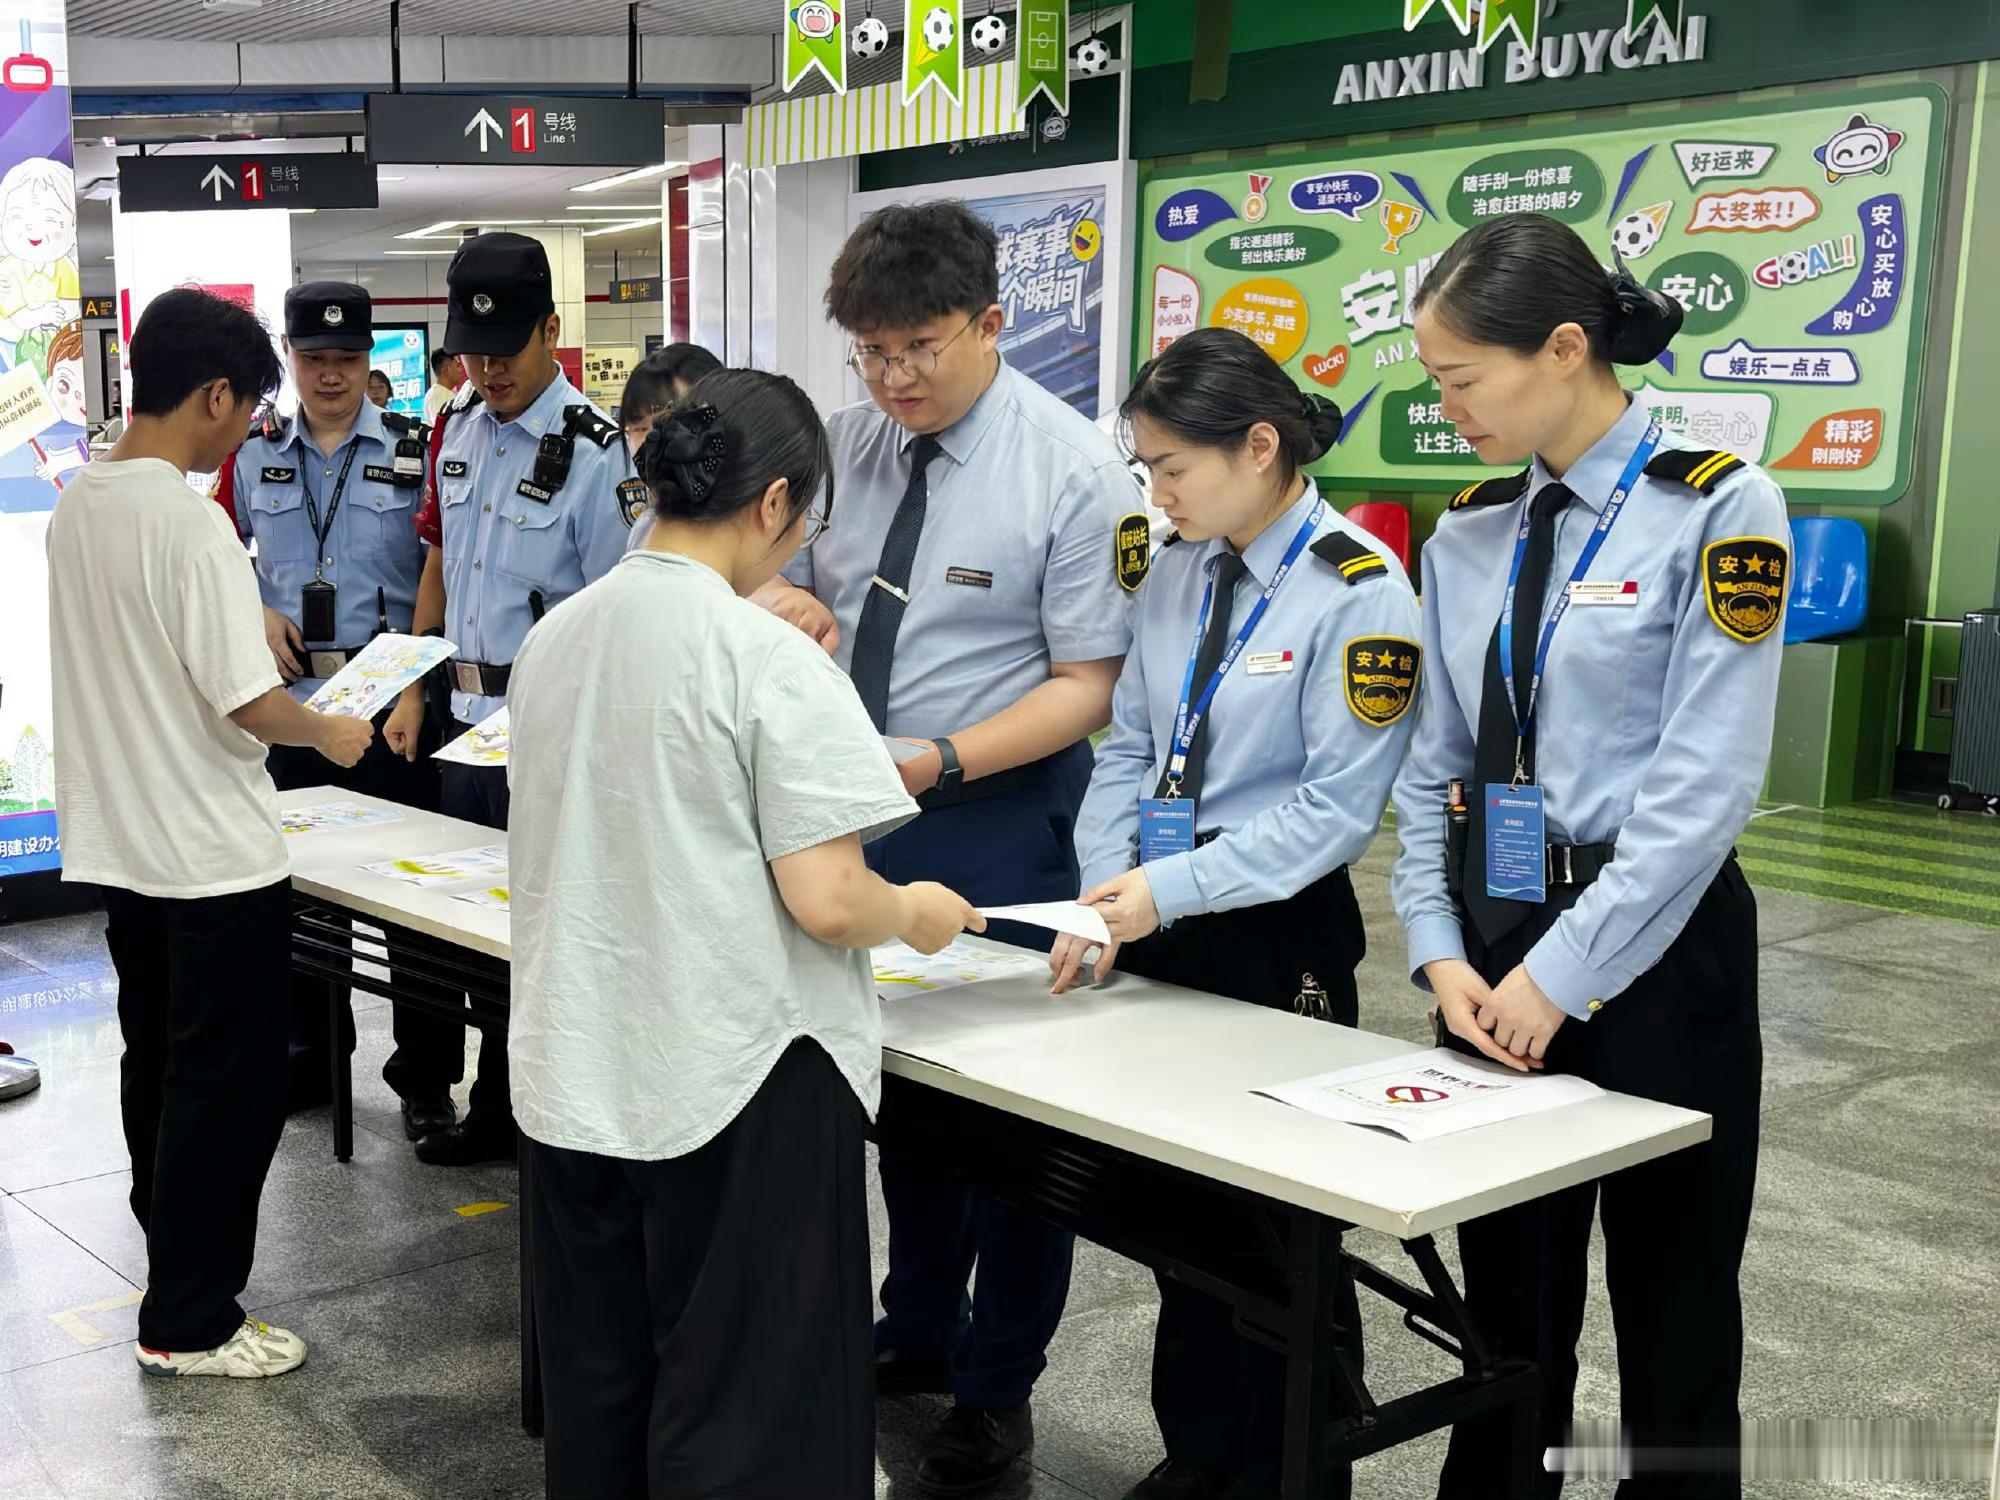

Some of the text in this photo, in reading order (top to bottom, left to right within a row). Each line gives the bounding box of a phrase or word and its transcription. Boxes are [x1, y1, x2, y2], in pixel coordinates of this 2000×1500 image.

[1332, 15, 1707, 105] ANXIN BUYCAI
[514, 111, 577, 149] 1 号线
[544, 133, 576, 143] Line 1
[1691, 148, 1755, 172] 好运来
[245, 165, 300, 197] 1 号线
[270, 183, 299, 192] Line 1
[1306, 180, 1350, 195] 享受小快乐
[1462, 166, 1573, 192] 随手刮一份惊喜
[1473, 190, 1583, 216] 治愈赶路的朝夕
[1168, 204, 1199, 227] 热爱
[1230, 232, 1295, 250] 指尖邂逅精彩
[1241, 248, 1307, 265] 刮出快乐美好
[1158, 294, 1192, 310] 每一份
[1660, 273, 1734, 313] 安心
[85, 300, 98, 316] A
[1157, 313, 1192, 327] 小小投入
[1312, 353, 1345, 376] LUCK!
[1729, 357, 1831, 378] 娱乐一点点
[1408, 402, 1455, 425] 快乐
[1692, 410, 1758, 446] 安心
[1825, 419, 1873, 445] 精彩
[1811, 447, 1863, 466] 刚刚好
[1718, 555, 1781, 578] 安 检
[1356, 651, 1412, 671] 安 检
